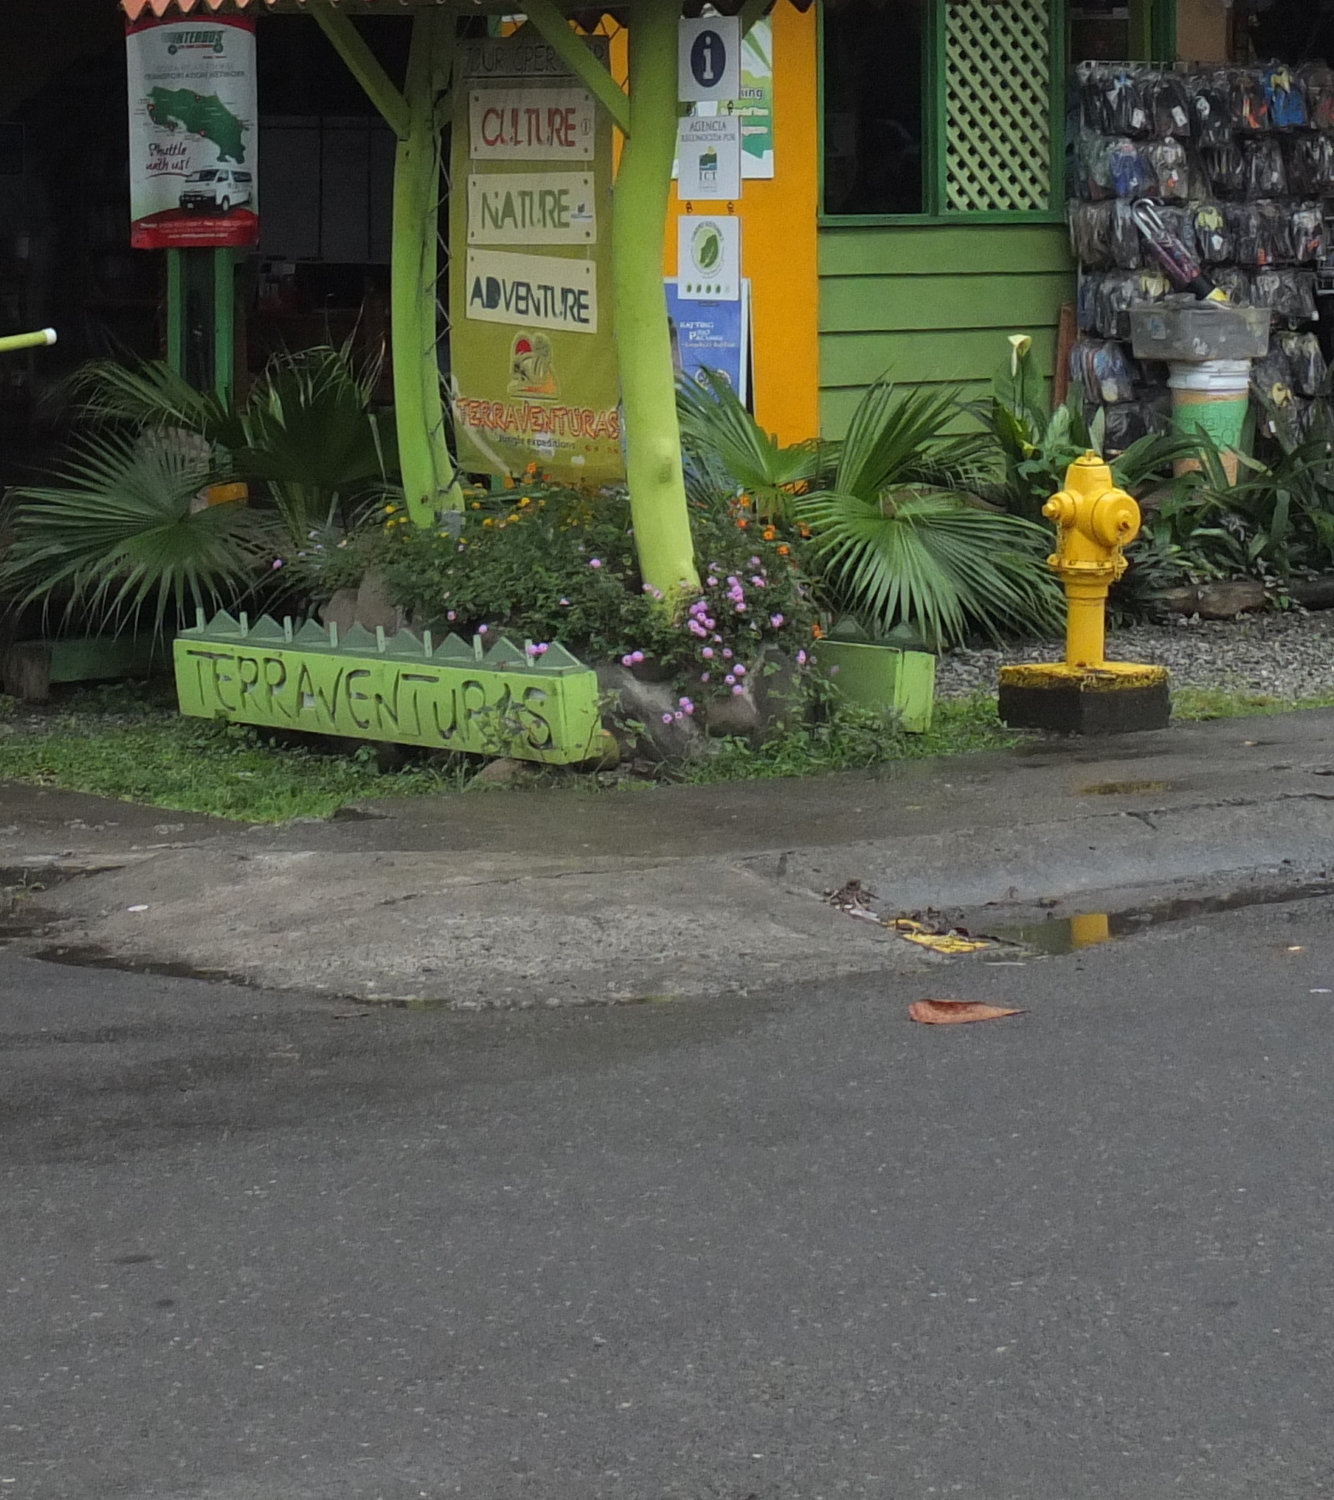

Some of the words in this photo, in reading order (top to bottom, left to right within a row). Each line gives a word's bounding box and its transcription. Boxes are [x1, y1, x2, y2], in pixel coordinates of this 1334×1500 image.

[482, 107, 576, 148] CULTURE
[689, 120, 727, 132] AGENCIA
[481, 188, 570, 229] NATURE
[470, 275, 590, 324] ADVENTURE
[456, 398, 622, 439] TERRAVENTURAS
